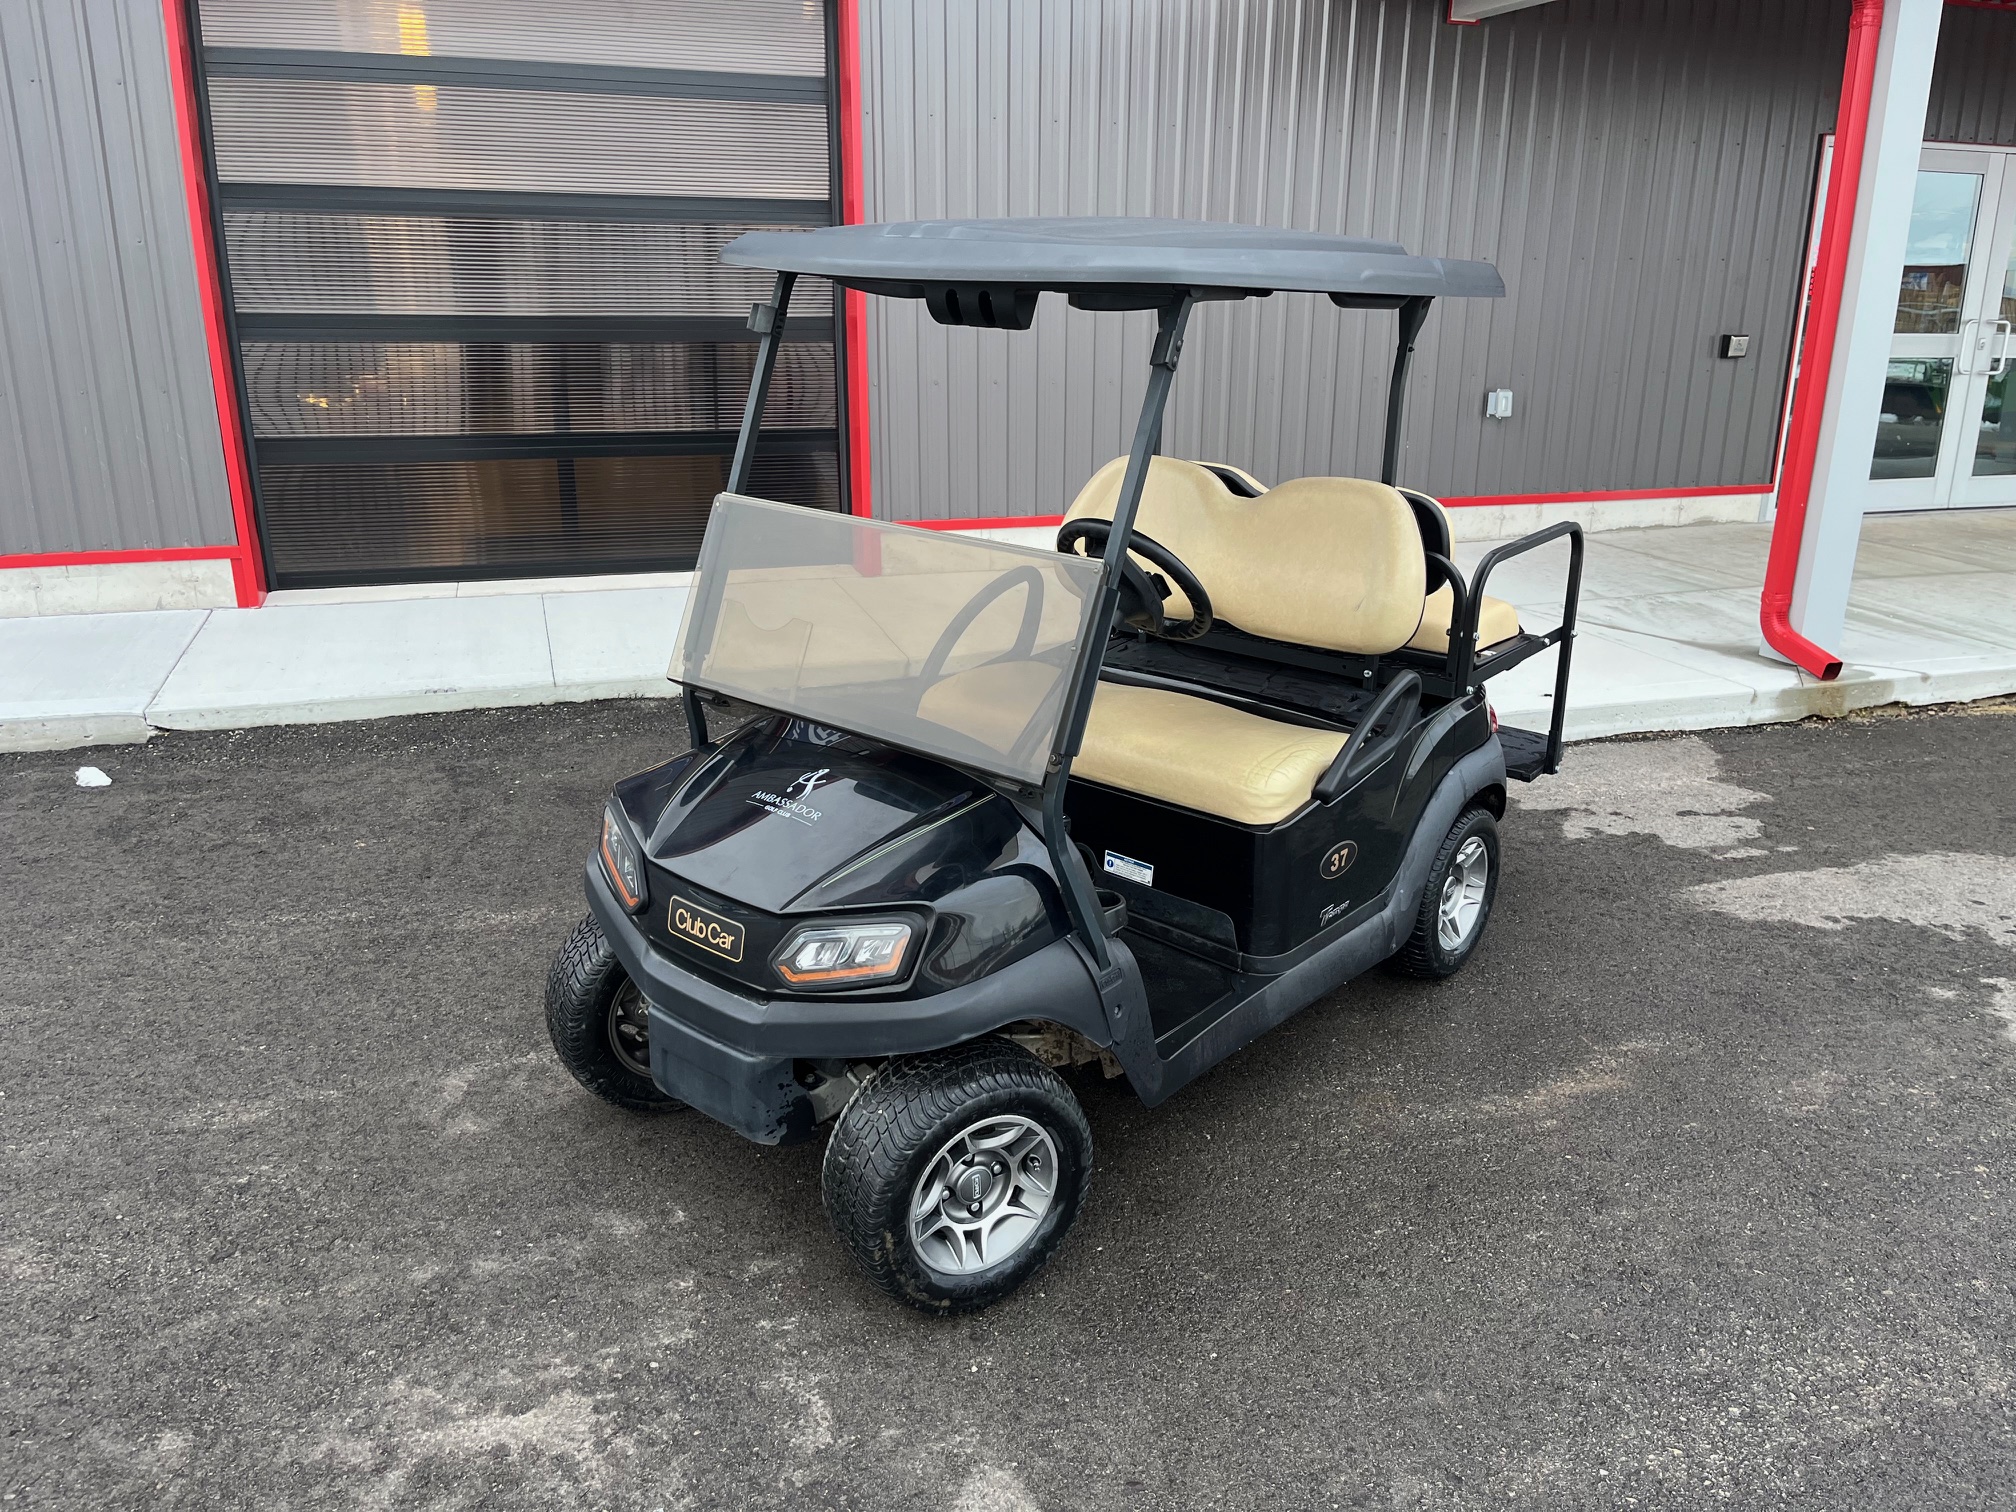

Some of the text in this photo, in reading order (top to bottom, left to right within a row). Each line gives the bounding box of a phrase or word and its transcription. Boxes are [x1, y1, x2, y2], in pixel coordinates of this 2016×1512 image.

[751, 790, 822, 821] AMBASSADOR
[1330, 848, 1349, 872] 37
[675, 908, 735, 950] Club Car
